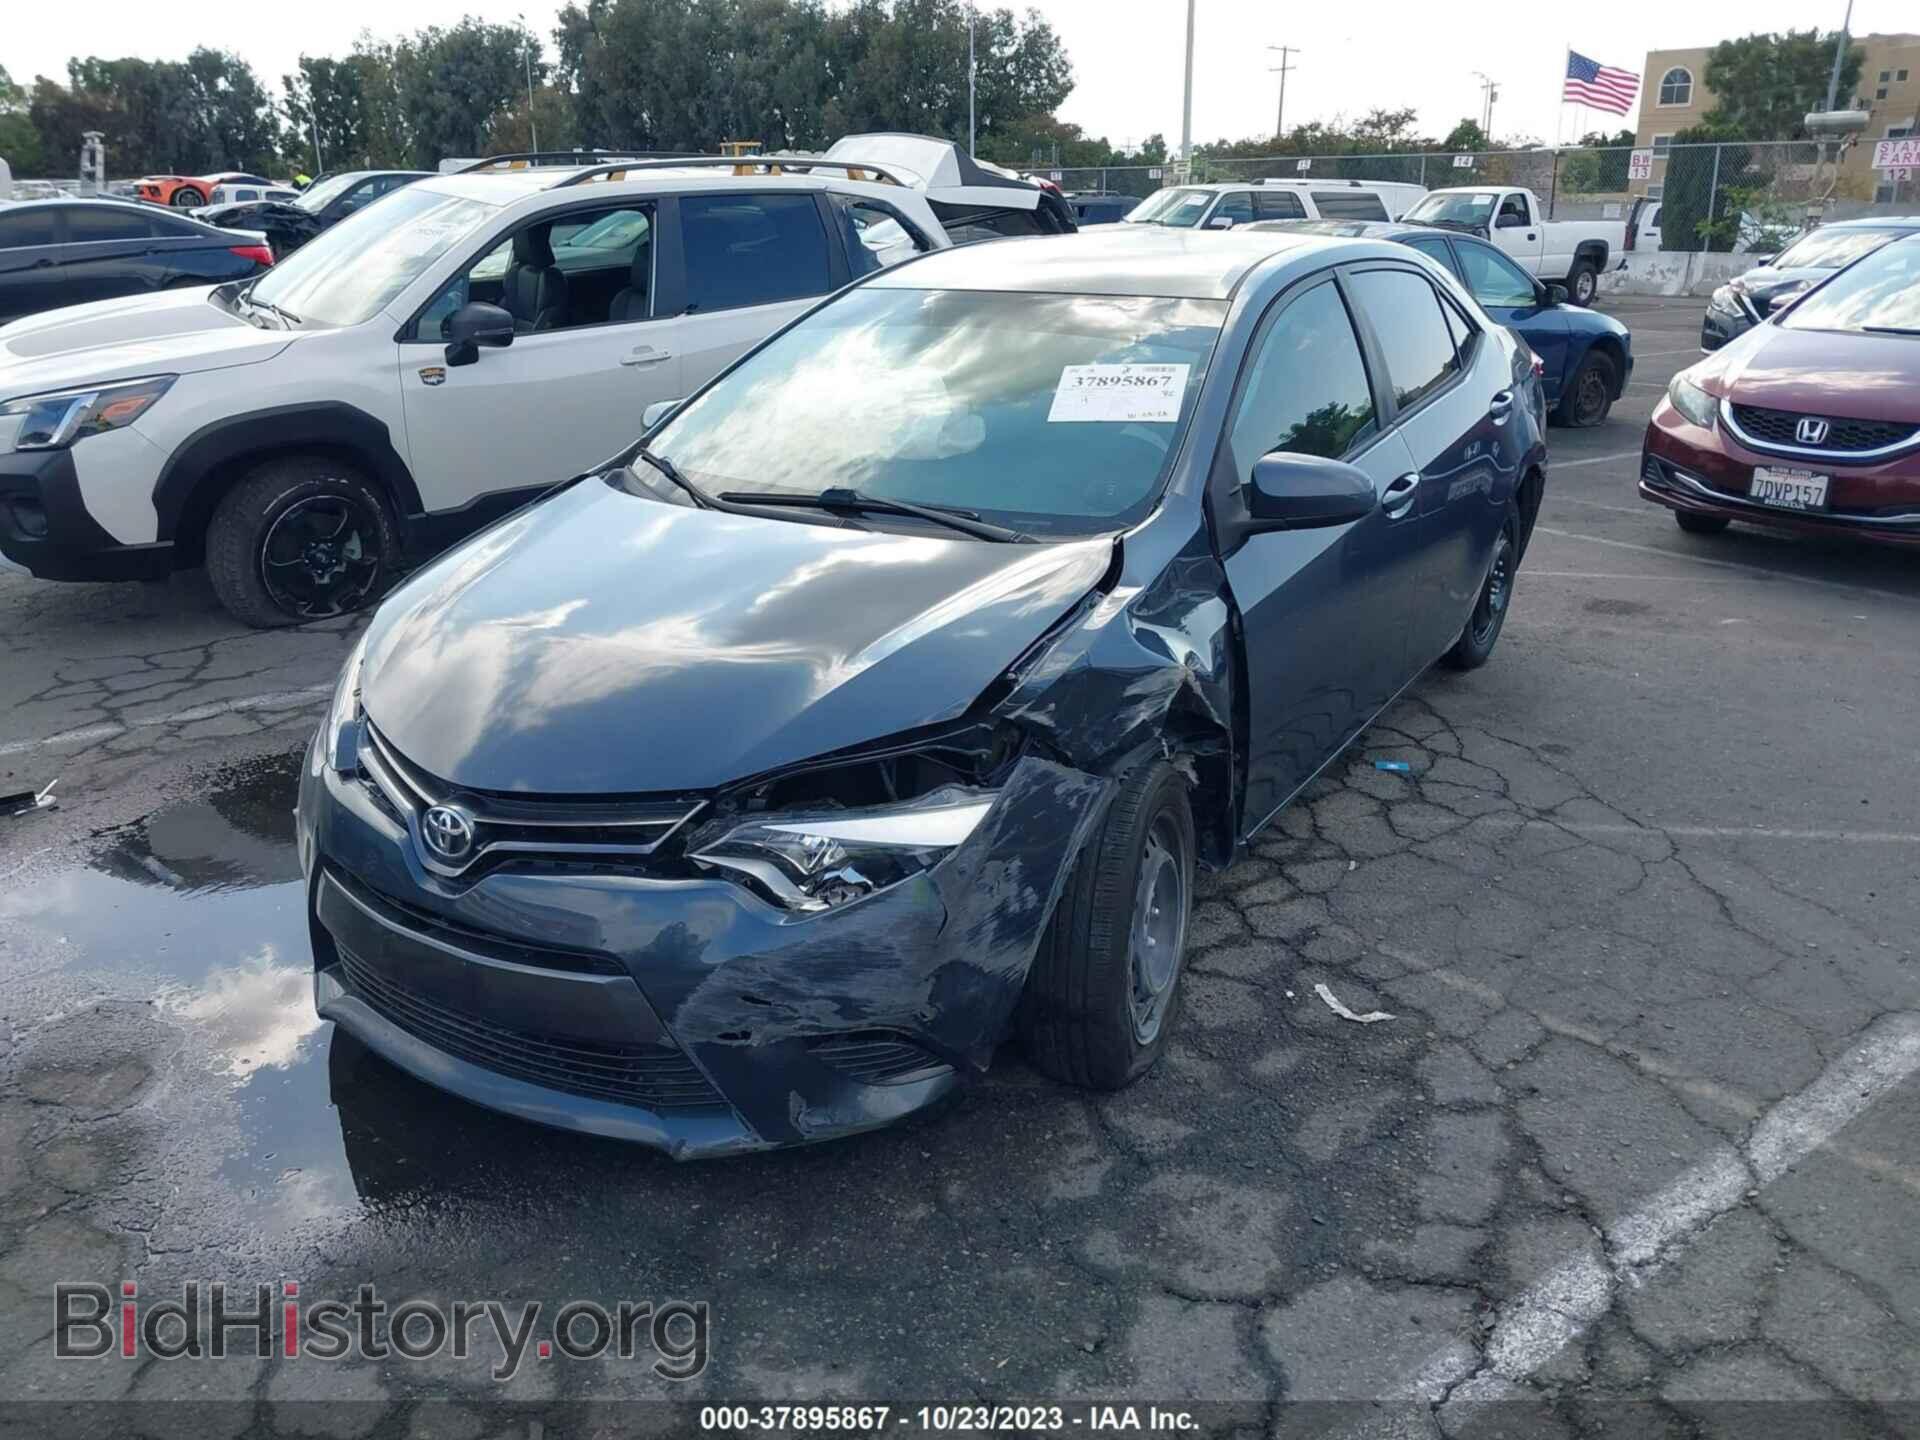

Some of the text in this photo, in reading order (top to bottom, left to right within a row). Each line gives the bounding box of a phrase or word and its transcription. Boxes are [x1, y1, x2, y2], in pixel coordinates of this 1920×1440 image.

[1633, 167, 1648, 178] 13
[1888, 168, 1906, 180] 12
[1072, 375, 1172, 387] 37895867
[1755, 480, 1823, 505] 7DVP157
